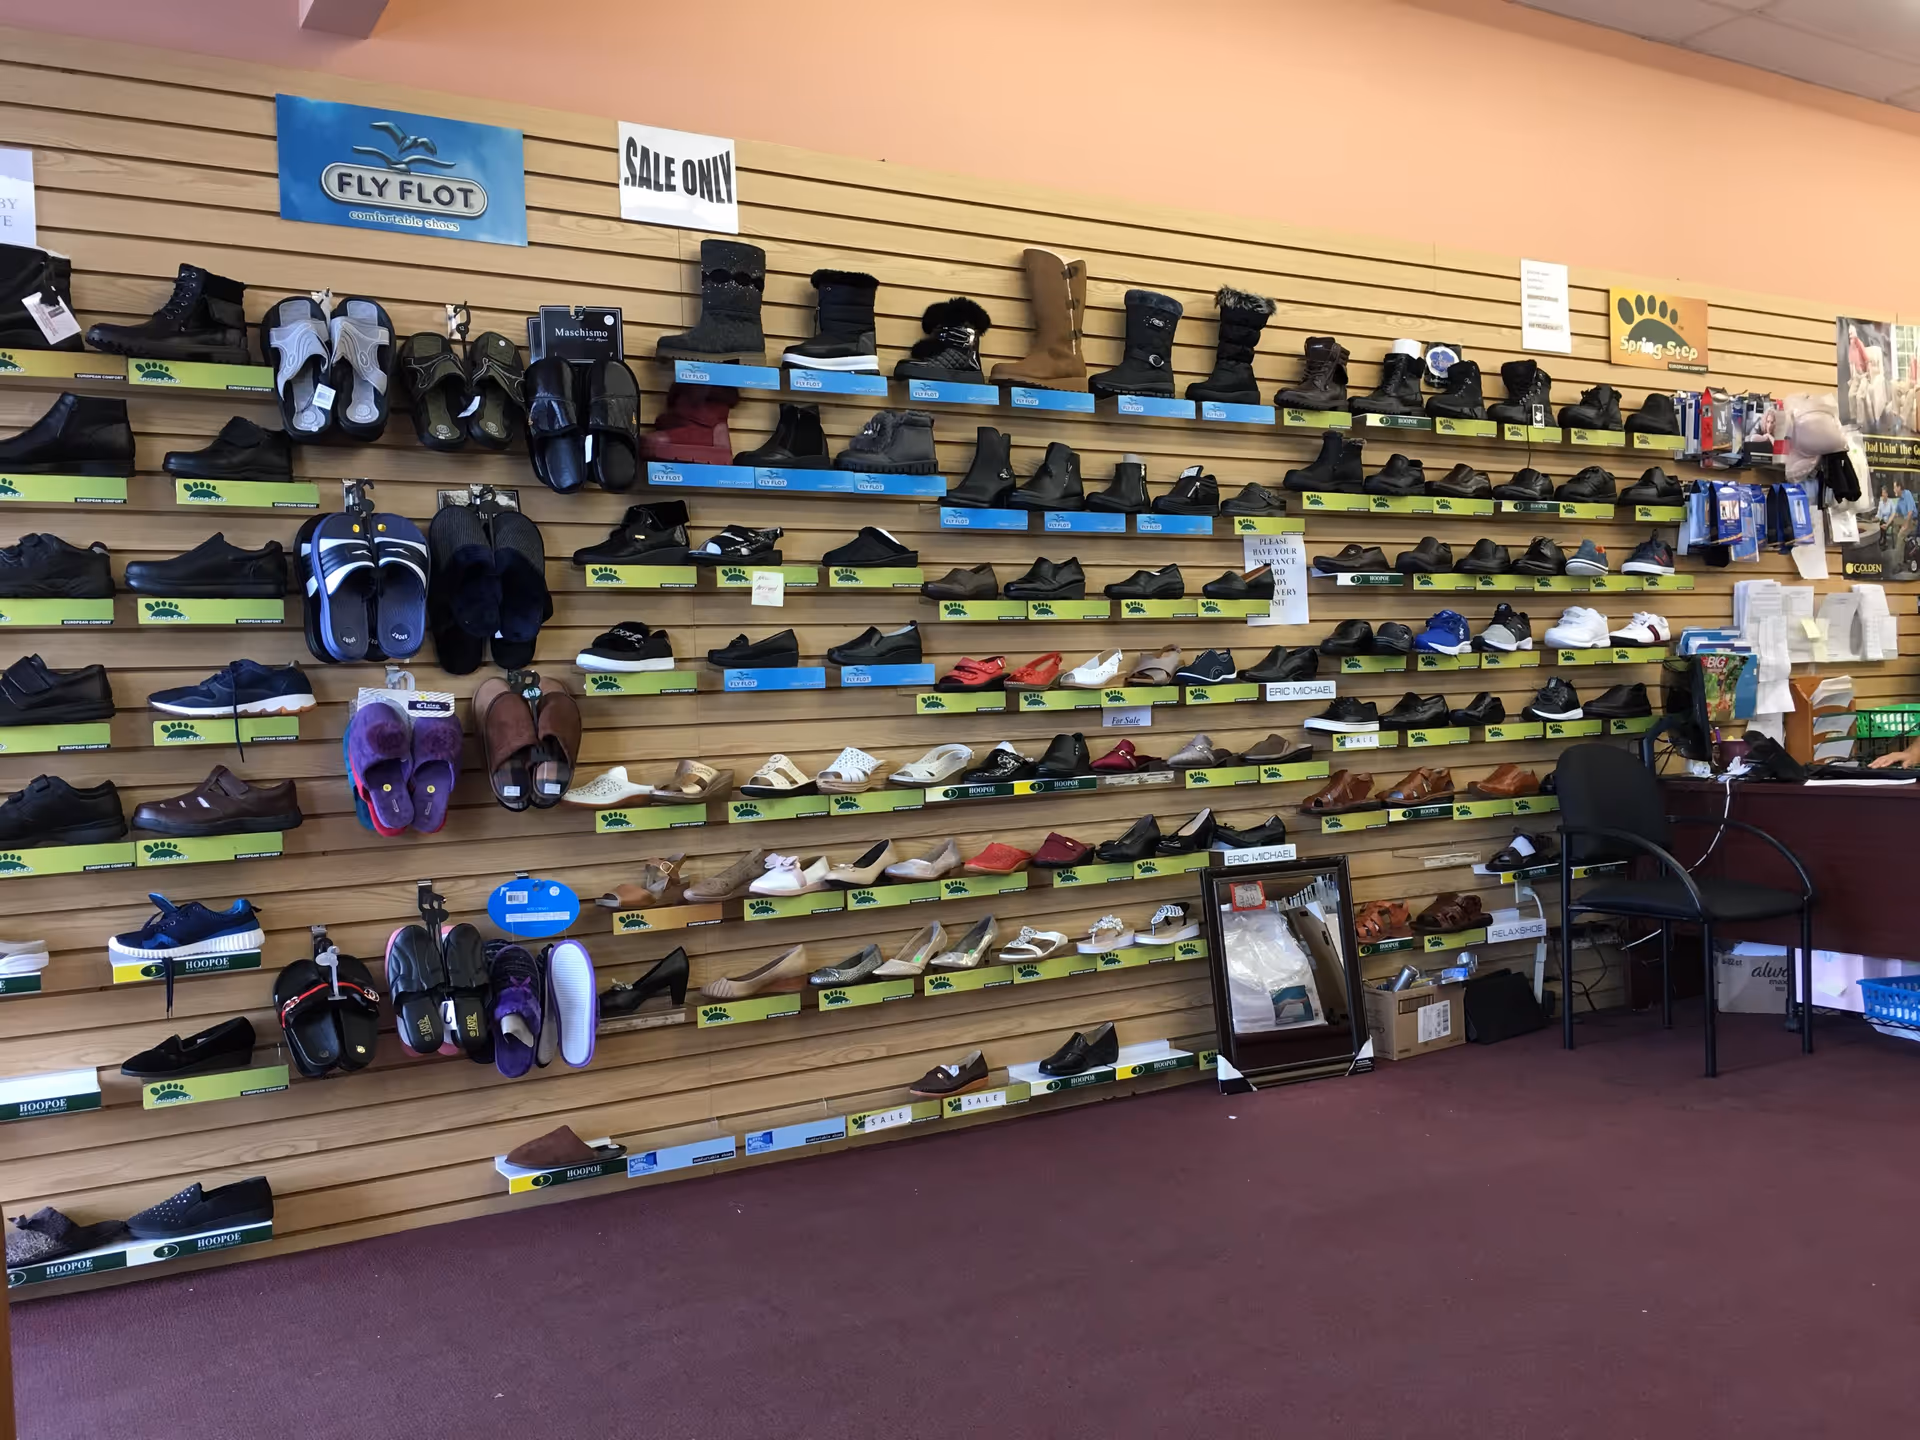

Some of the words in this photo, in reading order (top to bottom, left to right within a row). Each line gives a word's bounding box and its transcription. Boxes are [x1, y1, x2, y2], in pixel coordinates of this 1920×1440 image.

[624, 136, 677, 192] SALE
[682, 150, 733, 204] ONLY
[337, 172, 388, 197] FLY
[399, 180, 474, 208] FLOT
[349, 210, 422, 228] comfortable
[424, 218, 459, 231] shoes
[555, 328, 608, 337] Maschismo
[1620, 335, 1662, 359] Spring
[1666, 341, 1698, 361] Step
[1900, 443, 1912, 455] the
[1259, 537, 1288, 546] PLEASE
[1253, 548, 1272, 556] HAVE
[1274, 547, 1297, 556] YOUR
[1854, 563, 1882, 573] GOLDEN
[1707, 656, 1726, 667] BIG
[1269, 687, 1290, 696] ERIC
[1293, 685, 1334, 695] MICHAEL
[1124, 716, 1140, 724] Sale
[1349, 736, 1373, 744] SALE
[1227, 854, 1249, 864] ERIC
[1252, 850, 1294, 862] MICHAEL
[1492, 923, 1543, 938] RELAXSHOE
[186, 957, 230, 970] HOOPOE
[19, 1098, 67, 1112] HOOPOE
[967, 1093, 998, 1106] SALE
[871, 1112, 904, 1126] SALE
[567, 1164, 601, 1177] HOOPOE
[197, 1232, 241, 1247] HOOPOE
[46, 1259, 93, 1275] HOOPOE
